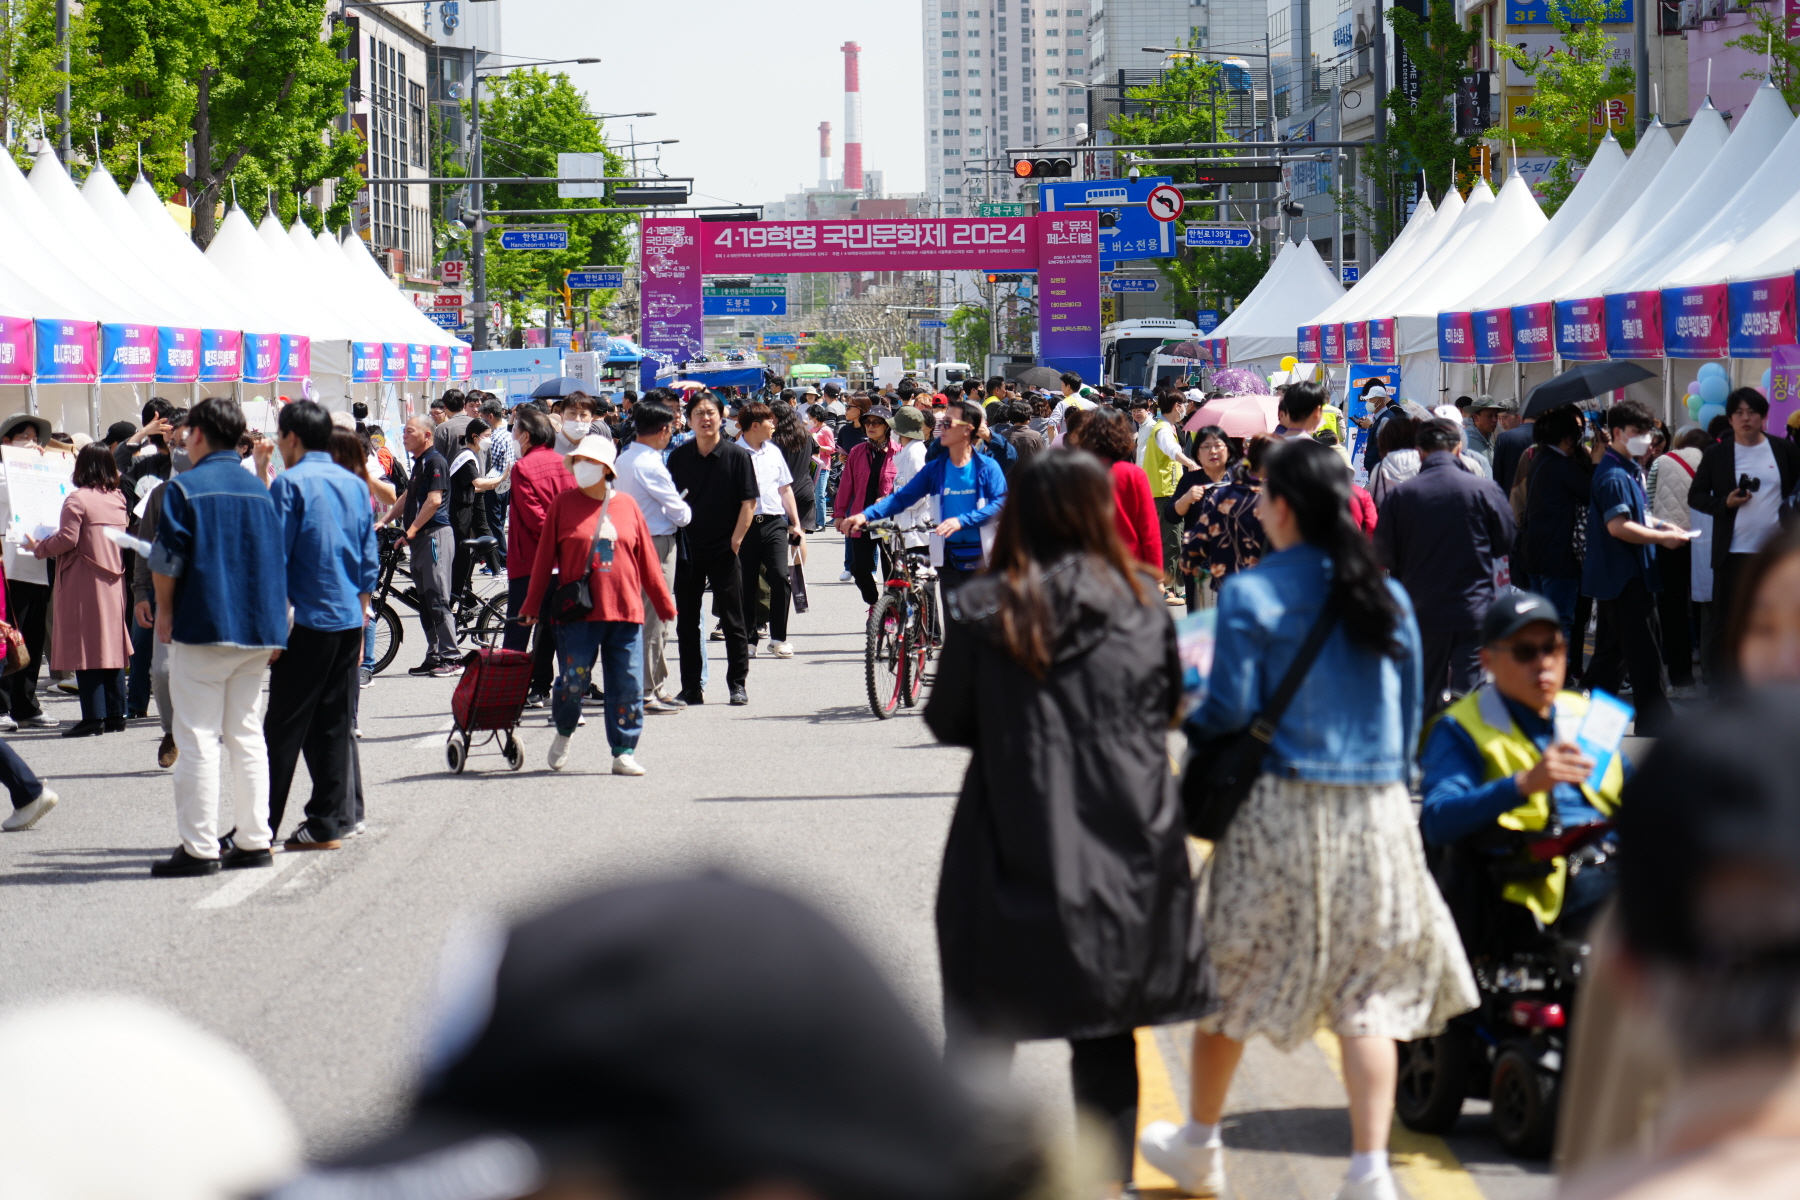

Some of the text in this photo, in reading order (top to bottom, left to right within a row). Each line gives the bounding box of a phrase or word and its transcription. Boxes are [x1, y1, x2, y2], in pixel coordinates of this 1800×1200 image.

[1515, 10, 1536, 21] 3F
[1463, 73, 1481, 126] 미용실
[982, 206, 1022, 216] 강북구청
[1069, 220, 1092, 232] 뮤직
[523, 233, 565, 242] 한천로140길
[714, 223, 1026, 250] 4·19혁명 국민문화제 2024
[1046, 233, 1092, 244] 페스티벌
[1188, 230, 1231, 238] 한천로139길
[646, 246, 674, 254] 2024
[1112, 238, 1158, 252] 버스전용
[444, 262, 464, 280] 약
[726, 299, 750, 307] 도봉로
